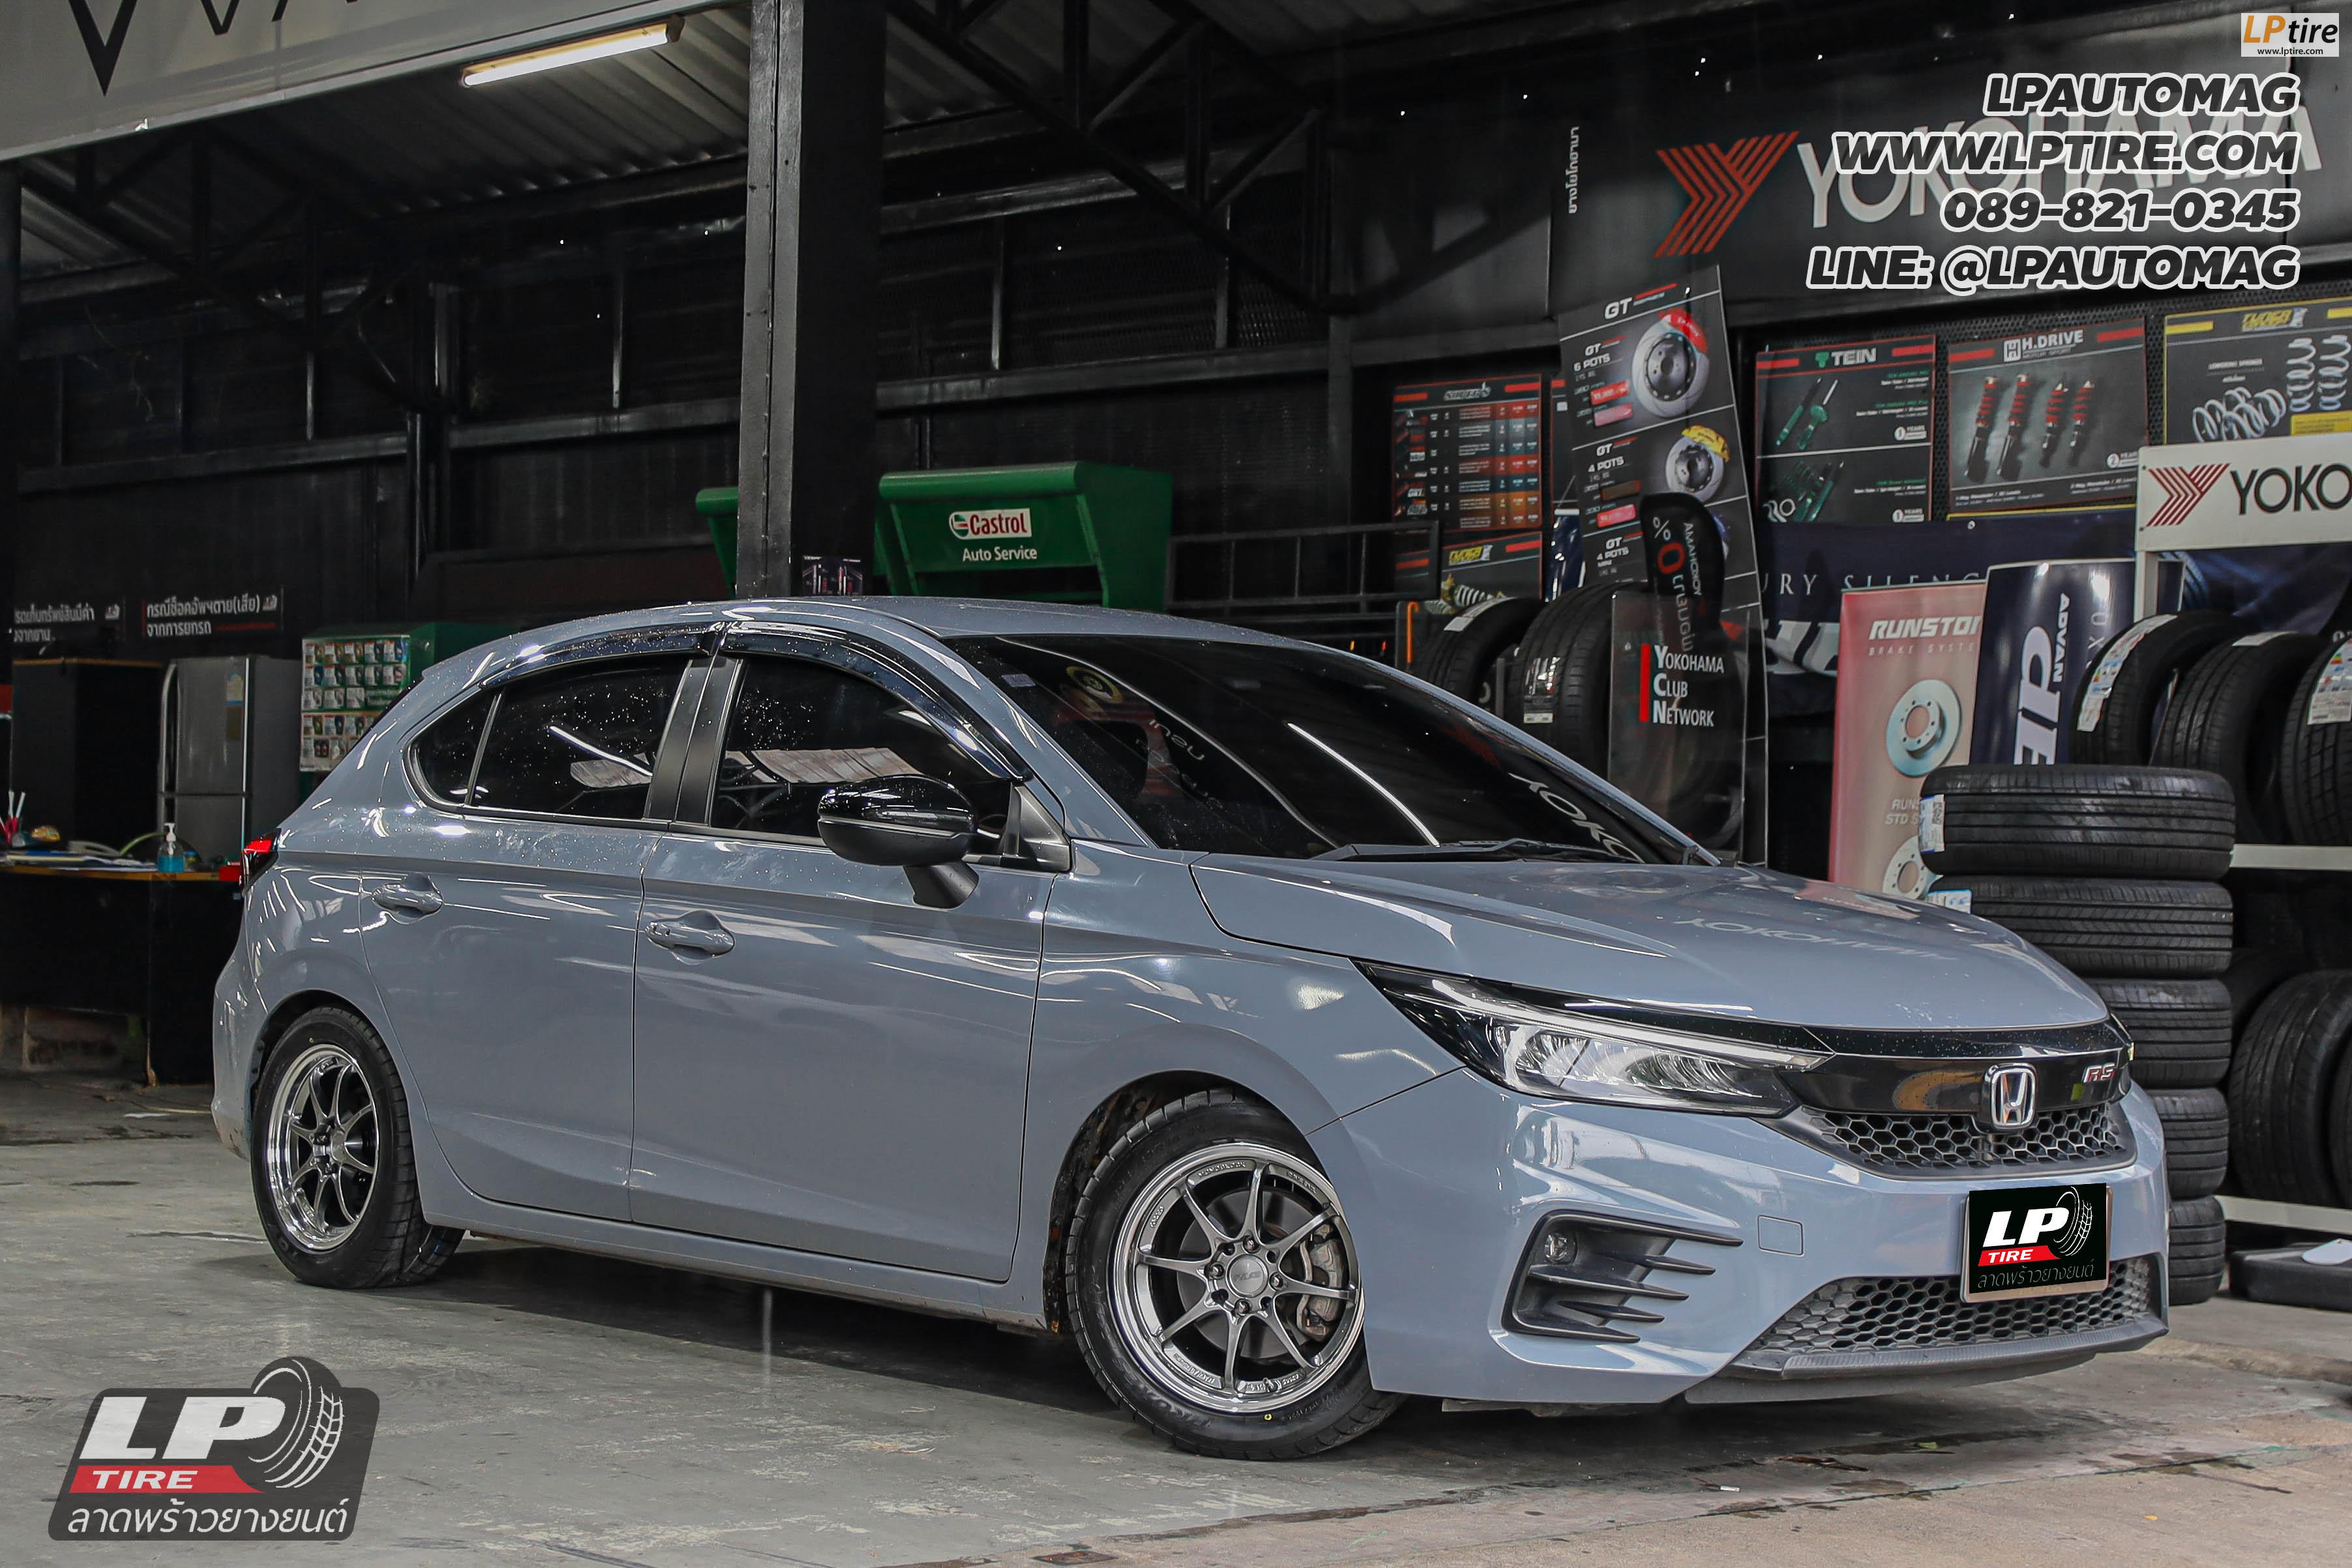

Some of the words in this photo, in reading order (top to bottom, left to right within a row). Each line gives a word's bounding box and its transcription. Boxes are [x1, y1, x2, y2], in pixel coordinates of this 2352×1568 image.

[1604, 297, 1632, 319] GT
[2022, 329, 2084, 351] H.DRIVE
[1585, 343, 1601, 356] GT
[1831, 348, 1877, 366] TEIN
[1583, 353, 1611, 369] POTS
[1596, 443, 1613, 457] GT
[1588, 464, 1595, 473] 4
[1597, 456, 1624, 471] POTS
[2230, 463, 2352, 516] YOKO
[970, 512, 1027, 536] Castrol
[1604, 546, 1630, 559] POTS
[1605, 537, 1623, 550] GT
[962, 548, 992, 562] Auto
[993, 546, 1037, 562] Service
[2053, 593, 2070, 683] ADVAN
[1653, 644, 1725, 674] YOKOHAMA
[1869, 645, 1914, 657] BRAKE
[1653, 673, 1688, 698] CLUB
[1653, 700, 1715, 727] NETWORK
[1886, 814, 1909, 825] STD
[2083, 1063, 2116, 1083] RS
